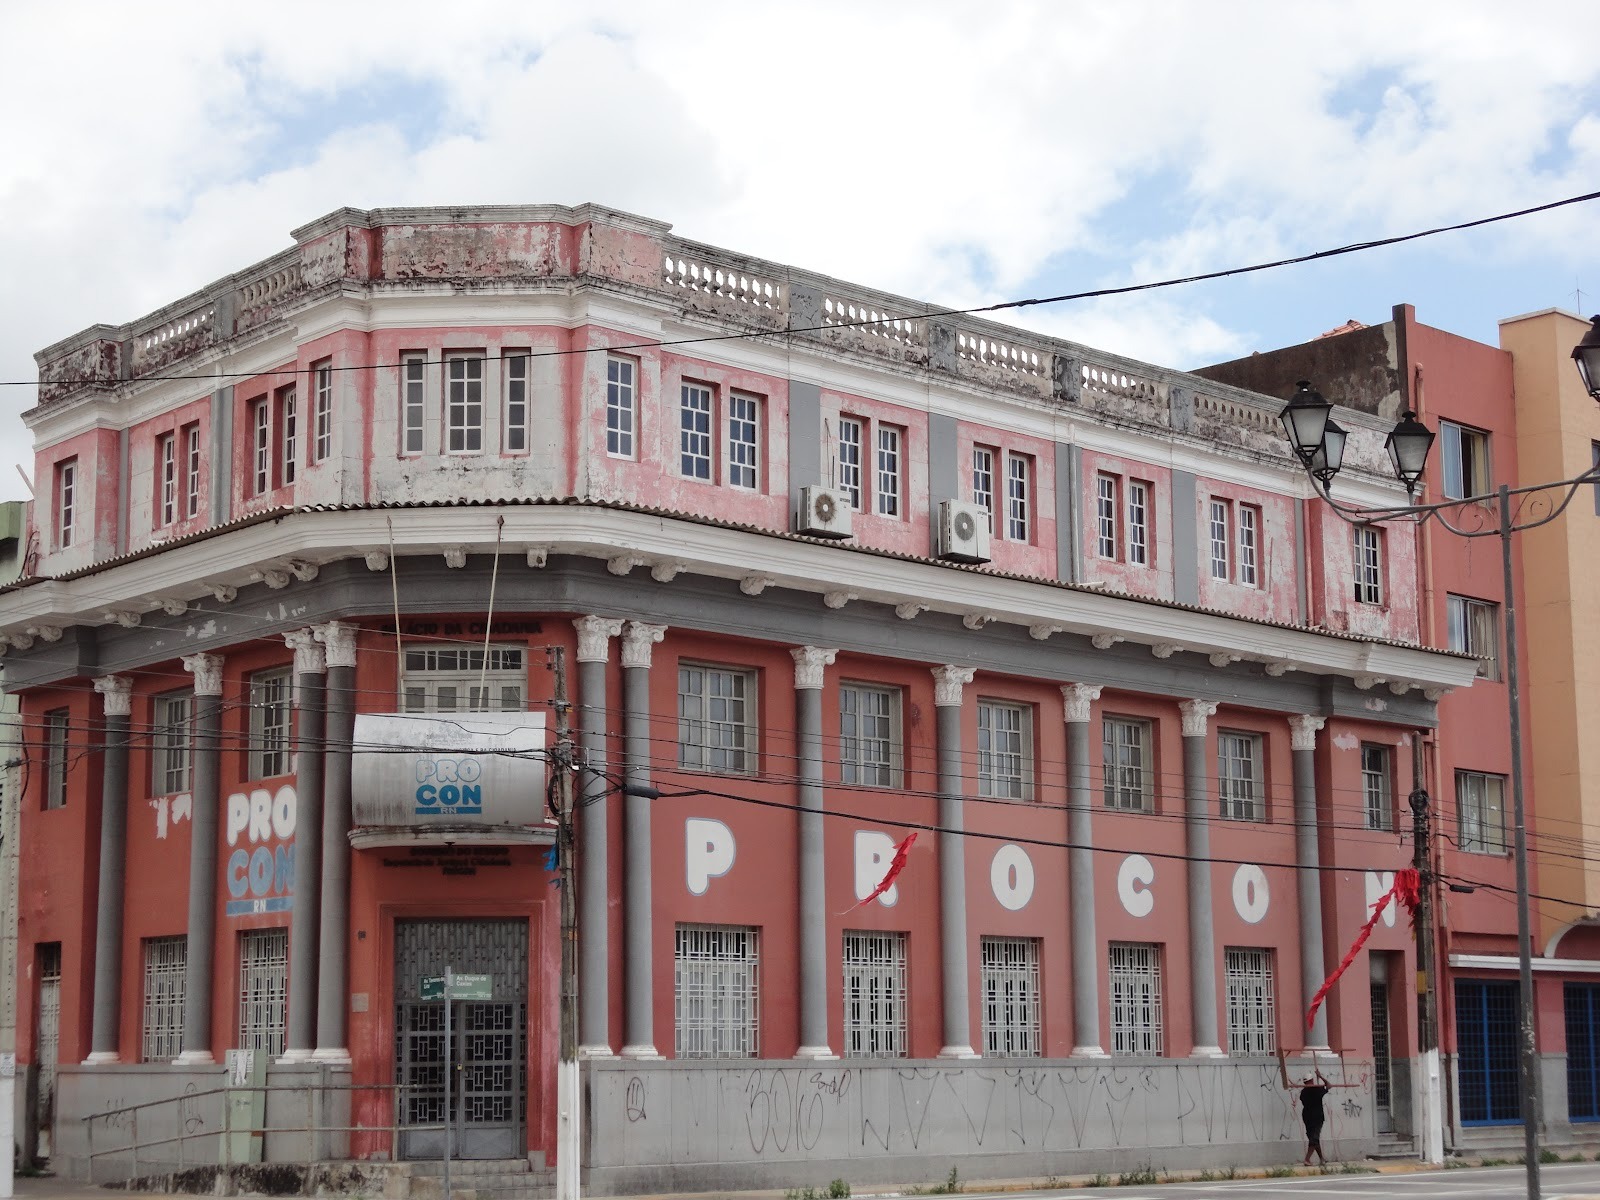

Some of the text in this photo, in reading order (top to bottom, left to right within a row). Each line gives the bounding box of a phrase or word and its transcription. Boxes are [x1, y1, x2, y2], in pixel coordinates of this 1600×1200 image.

[415, 758, 482, 783] PRO
[415, 784, 482, 806] CON
[227, 785, 297, 848] PRO
[227, 843, 296, 898] CON
[253, 899, 267, 913] RN
